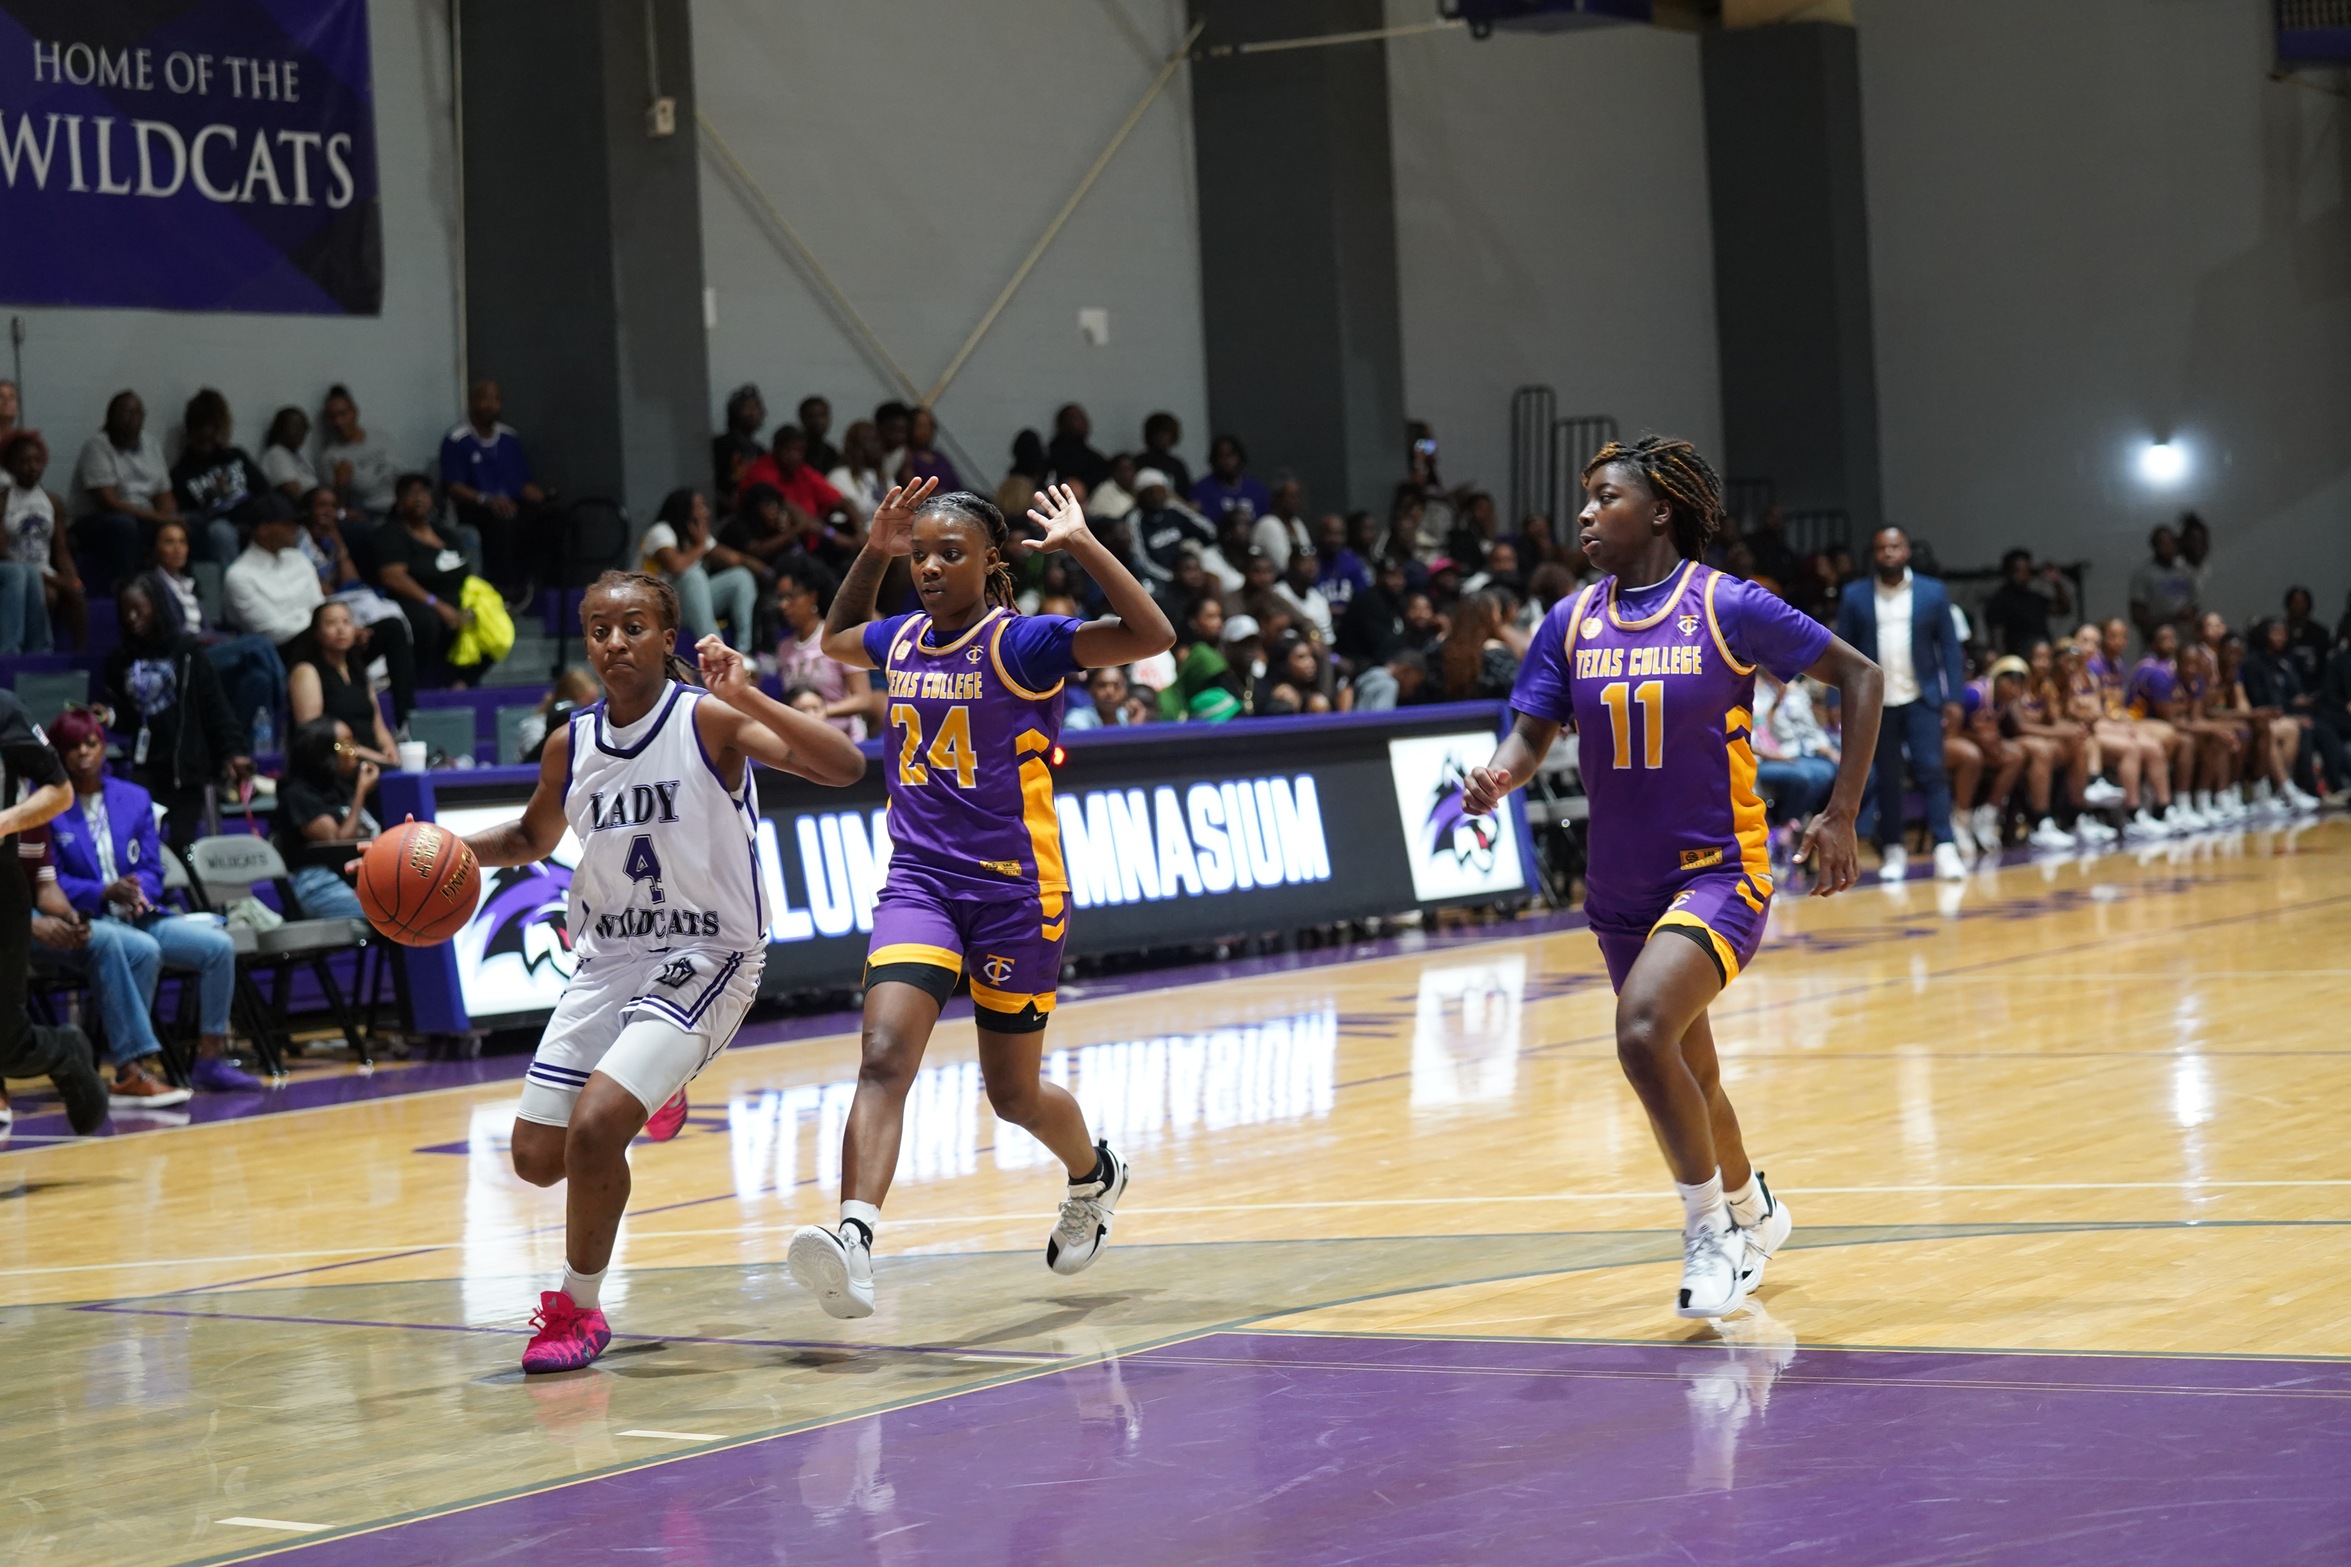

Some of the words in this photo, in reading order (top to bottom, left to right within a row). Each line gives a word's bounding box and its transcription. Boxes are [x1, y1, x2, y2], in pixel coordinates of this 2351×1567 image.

[33, 39, 154, 91] HOME
[164, 51, 214, 96] OF
[222, 54, 299, 103] THE
[0, 108, 354, 209] WILDCATS
[921, 671, 983, 699] COLLEGE
[1576, 648, 1624, 679] TEXAS
[1628, 645, 1702, 676] COLLEGE
[890, 703, 979, 789] 24
[1600, 680, 1664, 769] 11
[590, 780, 680, 832] LADY
[622, 834, 666, 905] 4
[1053, 773, 1332, 910] MNASIUM
[595, 907, 721, 939] WILDCATS
